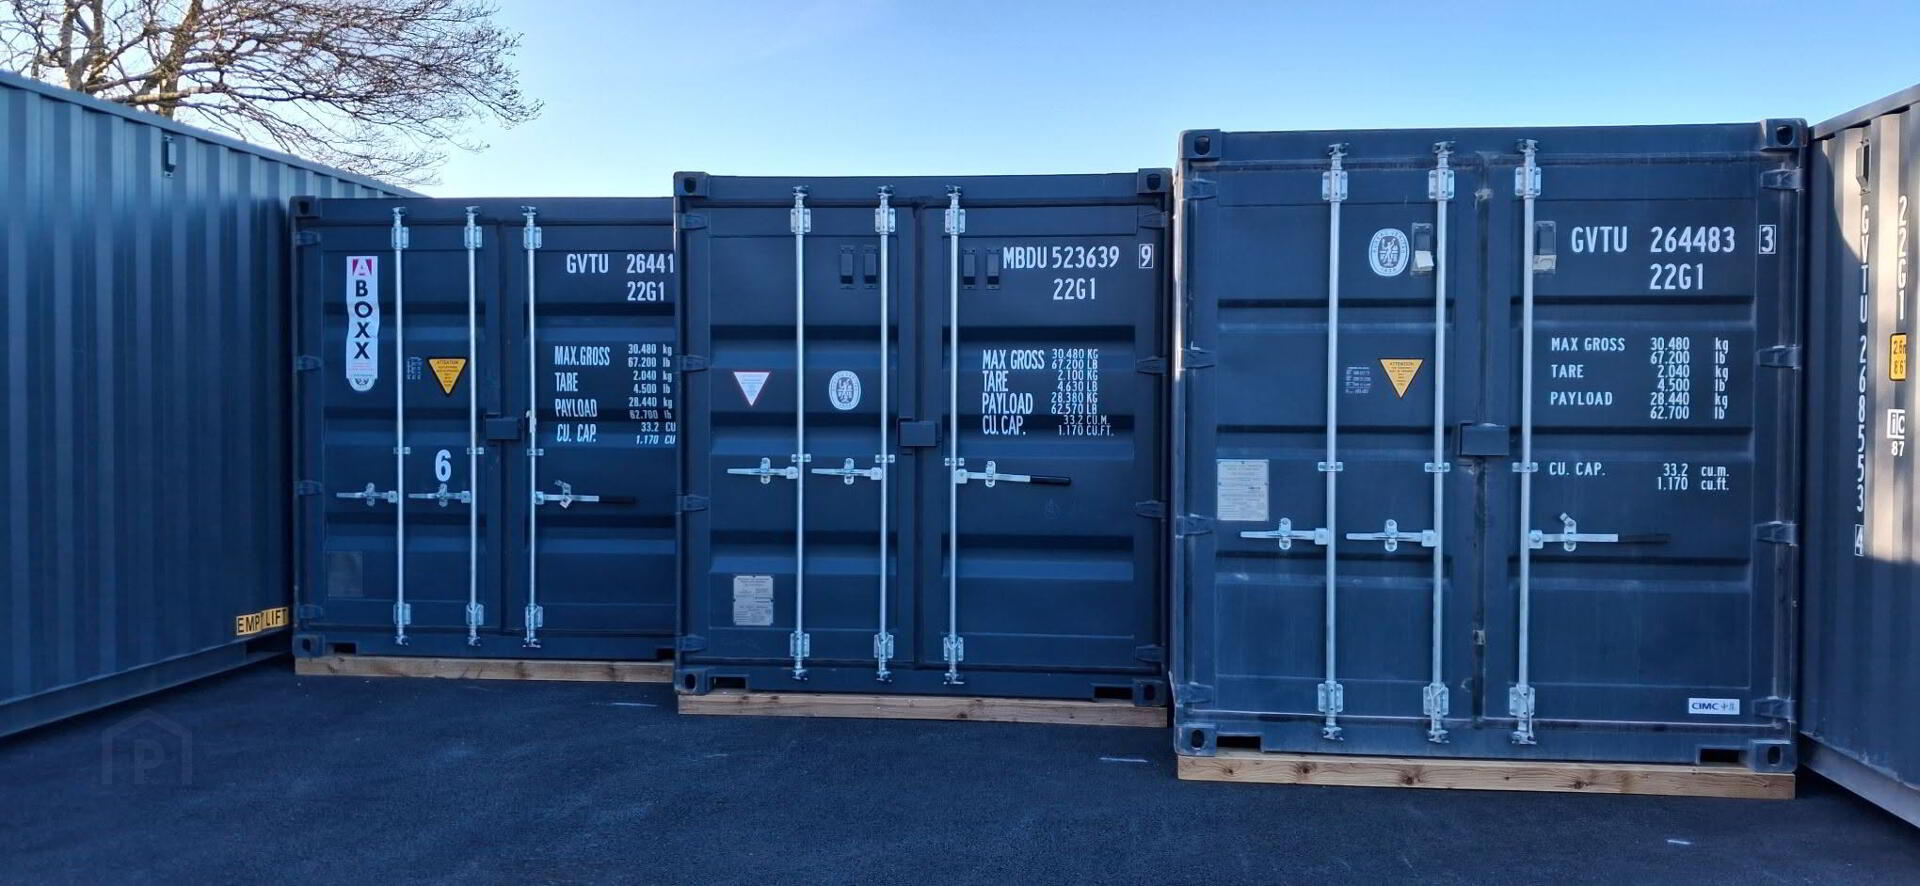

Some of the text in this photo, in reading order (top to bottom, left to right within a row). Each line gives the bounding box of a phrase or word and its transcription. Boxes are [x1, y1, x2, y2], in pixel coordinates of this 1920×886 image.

[1572, 226, 1775, 253] GVTU 264483 3
[566, 254, 674, 274] GVTU 26441
[1003, 245, 1152, 269] MBDU 523639 9
[1898, 195, 1908, 320] 22G1
[1650, 263, 1704, 290] 22G1
[627, 281, 665, 302] 22G1
[1053, 277, 1096, 300] 22G1
[352, 258, 373, 359] ABOXX
[628, 344, 657, 354] 30.480
[663, 344, 672, 356] kg
[1551, 337, 1729, 354] MAX GROSS 30.480 kg
[628, 357, 670, 367] 67.200 lb
[982, 348, 1099, 370] MAX GROSS 30.480 KG
[1051, 360, 1098, 370] 67.200 LB
[1650, 351, 1726, 364] 67.200 lb
[554, 370, 672, 392] TARE 2.040 kg
[982, 370, 1098, 392] TARE 2.100 KG
[1551, 364, 1729, 382] TARE 2.040 kg
[1855, 204, 1869, 555] GVTU 268553 4
[633, 383, 670, 394] 4.500 lb
[1057, 381, 1098, 392] 4.630 LB
[1657, 378, 1726, 392] 4.500 lb
[555, 397, 673, 418] PAYLOAD 28.440 kg
[982, 392, 1098, 414] PAYLOAD 28.380 KG
[1051, 404, 1098, 414] 62.570 LB
[1550, 392, 1728, 409] PAYLOAD 28.440 kg
[629, 410, 658, 420] 62.700
[1063, 415, 1084, 425] 33.2
[1650, 406, 1725, 420] 62.700 lb
[557, 424, 572, 442] CU.
[577, 424, 597, 442] CAP.
[641, 422, 659, 432] 33.2
[1058, 425, 1084, 436] 1.170
[636, 435, 659, 445] 1.170
[1891, 441, 1905, 456] 87
[435, 449, 451, 481] 6
[1549, 462, 1730, 477] CU. CAP. 33.2 cu.m.
[1657, 477, 1729, 491] 1.170 cu.ft.
[265, 608, 288, 626] LIFT
